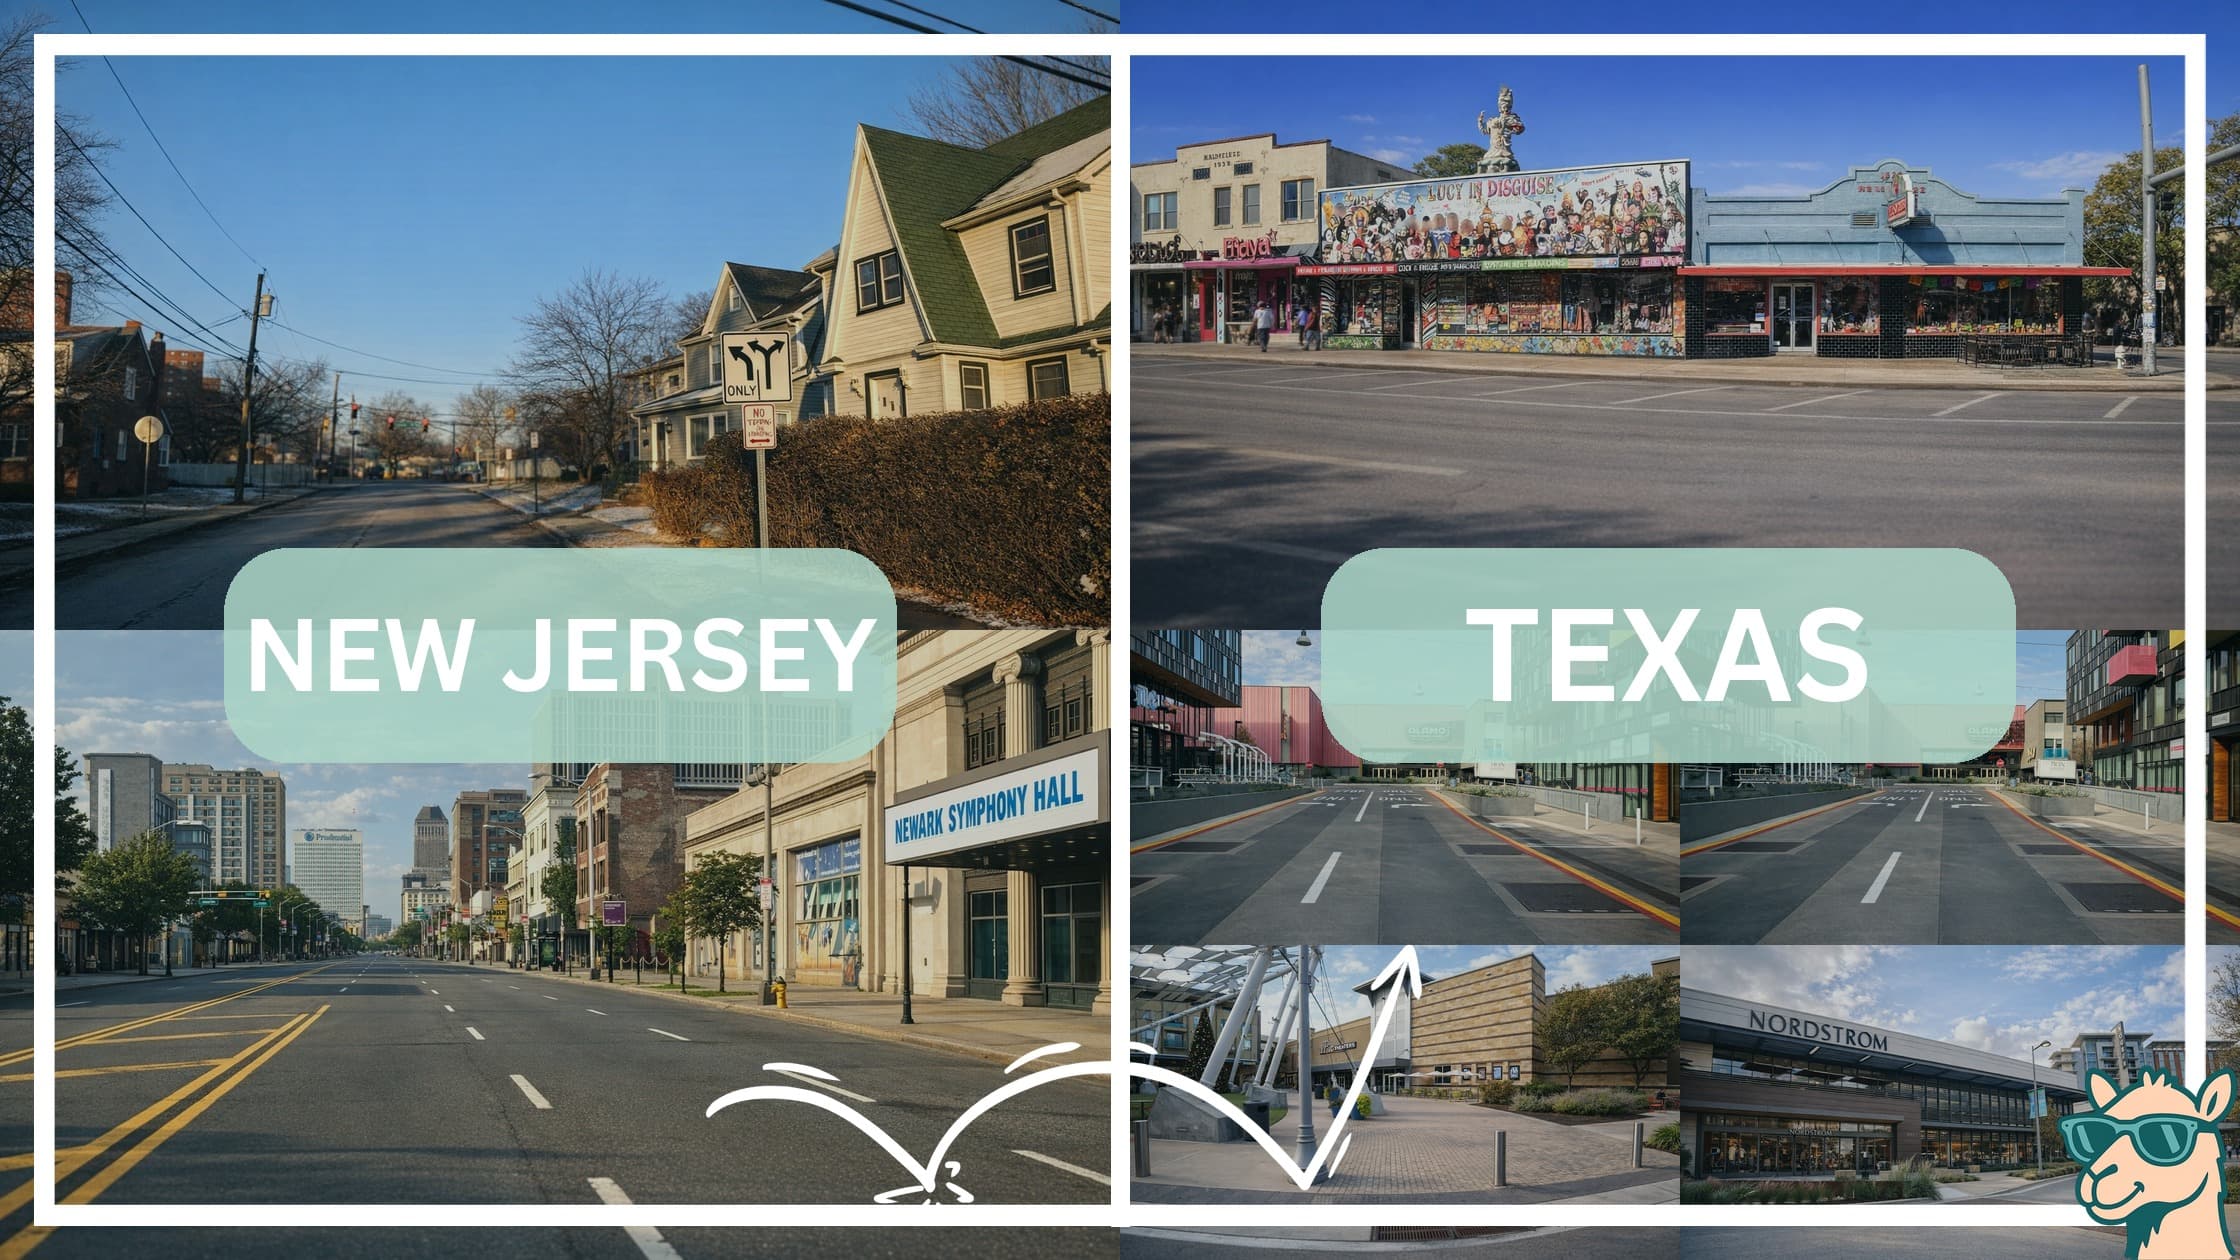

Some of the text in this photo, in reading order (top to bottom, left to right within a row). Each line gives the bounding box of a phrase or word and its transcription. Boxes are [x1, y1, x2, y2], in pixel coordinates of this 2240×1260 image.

[1427, 183, 1464, 202] LUCY
[1468, 180, 1483, 200] IN
[1487, 176, 1555, 198] DISGUISE
[728, 385, 757, 396] ONLY
[753, 408, 765, 418] NO
[895, 770, 1084, 844] NEWARK SYMPHONY HALL
[316, 833, 353, 841] Prudential
[1750, 1009, 1888, 1051] NORDSTROM
[1788, 1129, 1833, 1137] NORDSTROM
